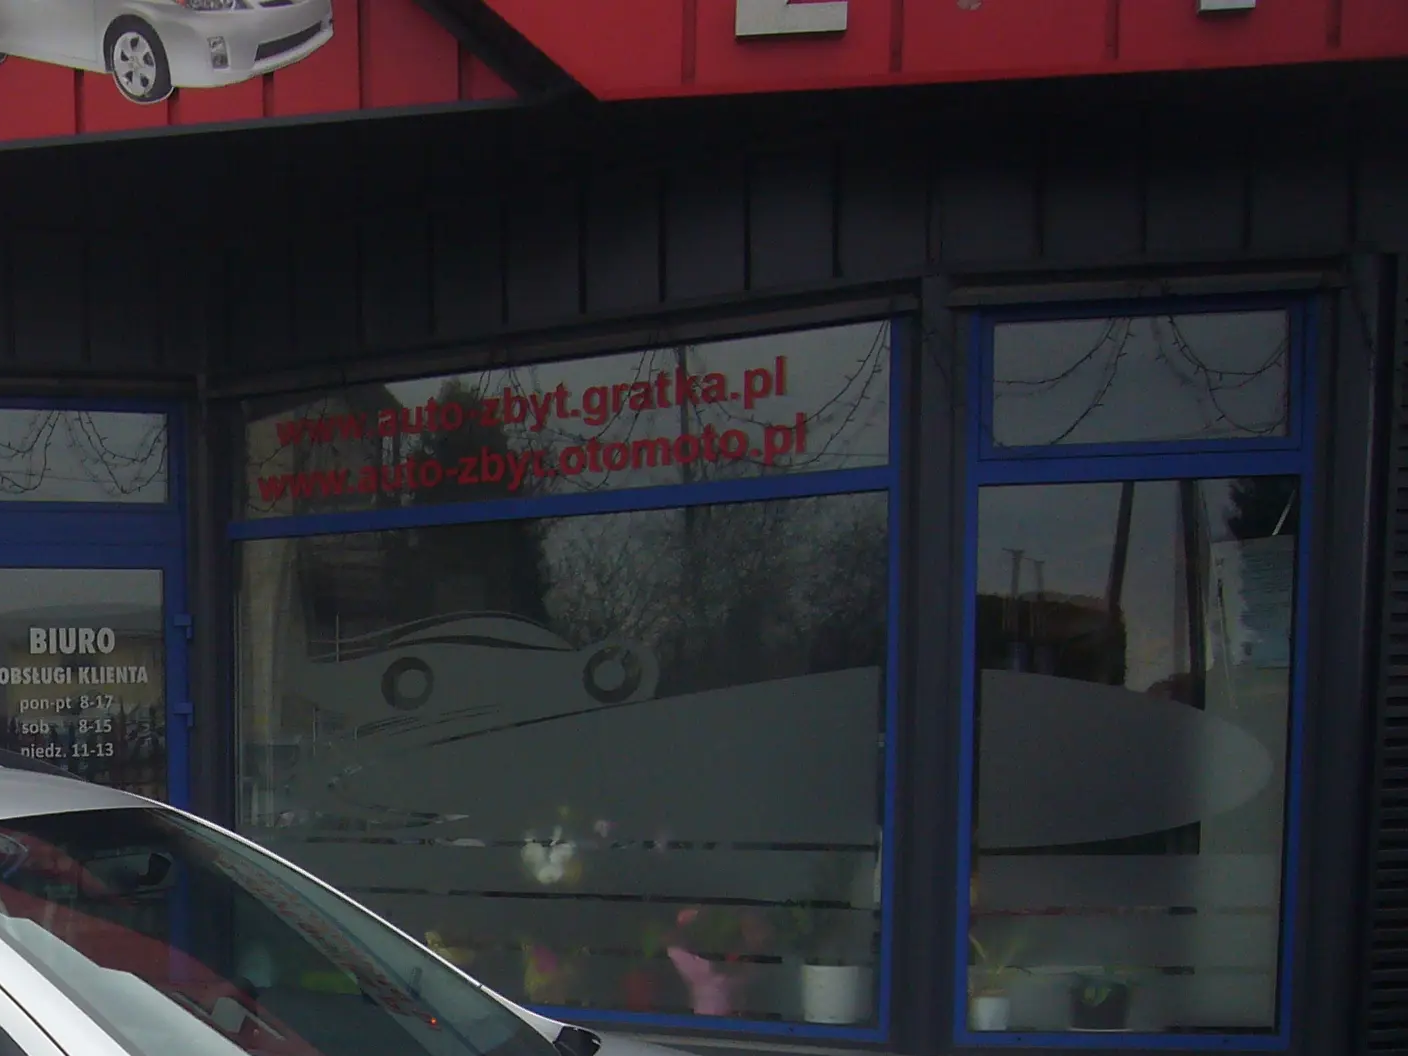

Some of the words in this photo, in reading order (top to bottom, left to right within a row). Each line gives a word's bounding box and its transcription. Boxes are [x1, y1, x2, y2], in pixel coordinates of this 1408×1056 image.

[275, 355, 787, 446] www.auto-zbyt.gratka.pl
[257, 412, 807, 502] www.auto-zbyt.otomoto.pl
[29, 627, 115, 654] BIURO
[78, 666, 148, 684] KLIENTA
[20, 696, 72, 712] pon-pt
[79, 694, 114, 710] 8-17
[22, 719, 49, 734] sob
[79, 718, 112, 734] 8-15
[20, 743, 67, 758] niedz.
[71, 742, 114, 757] 11-13
